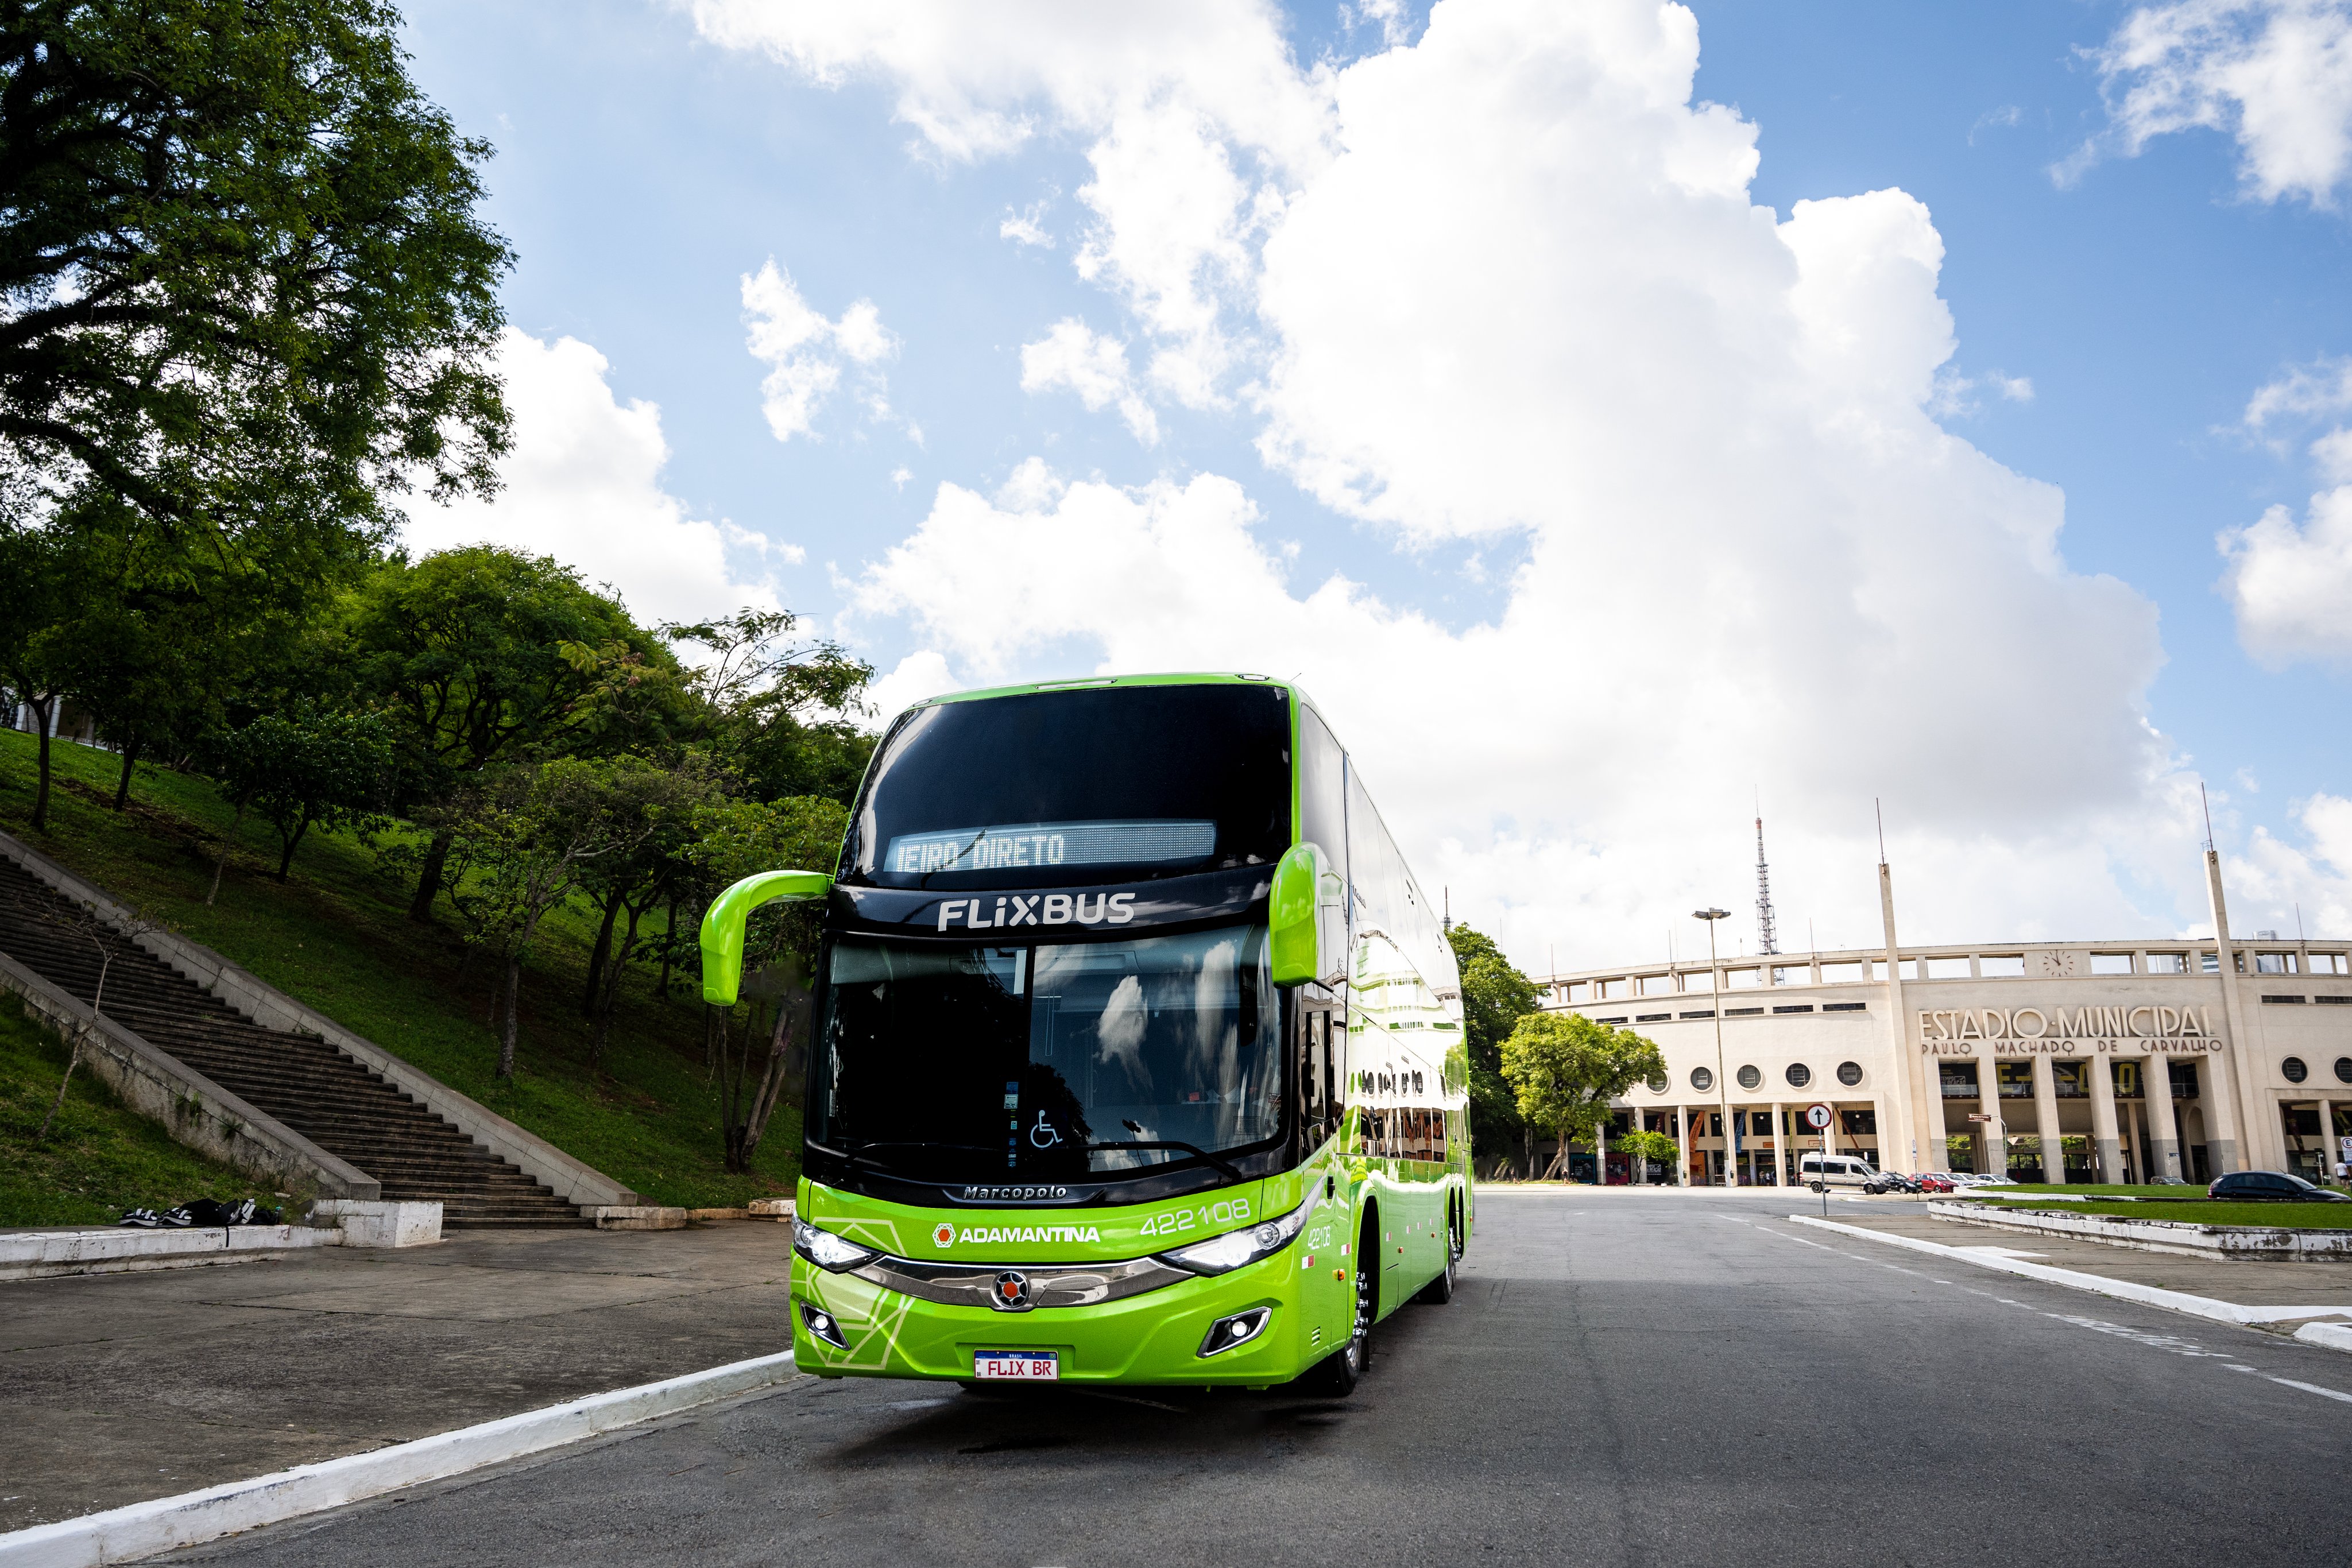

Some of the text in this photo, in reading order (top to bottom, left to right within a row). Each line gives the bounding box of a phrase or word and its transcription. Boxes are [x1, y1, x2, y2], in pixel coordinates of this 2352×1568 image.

[973, 834, 1063, 869] DIRETO
[1918, 1006, 2216, 1040] ESTADIO MUNICIPAL
[1921, 1040, 2222, 1055] PAULO MACHADO DE CARVALHO
[963, 1186, 1067, 1201] Marcopolo
[1140, 1198, 1251, 1236] 422108
[959, 1228, 1100, 1243] ADAMANTINA
[1307, 1225, 1330, 1250] 422108
[988, 1361, 1051, 1376] FLIX BR
